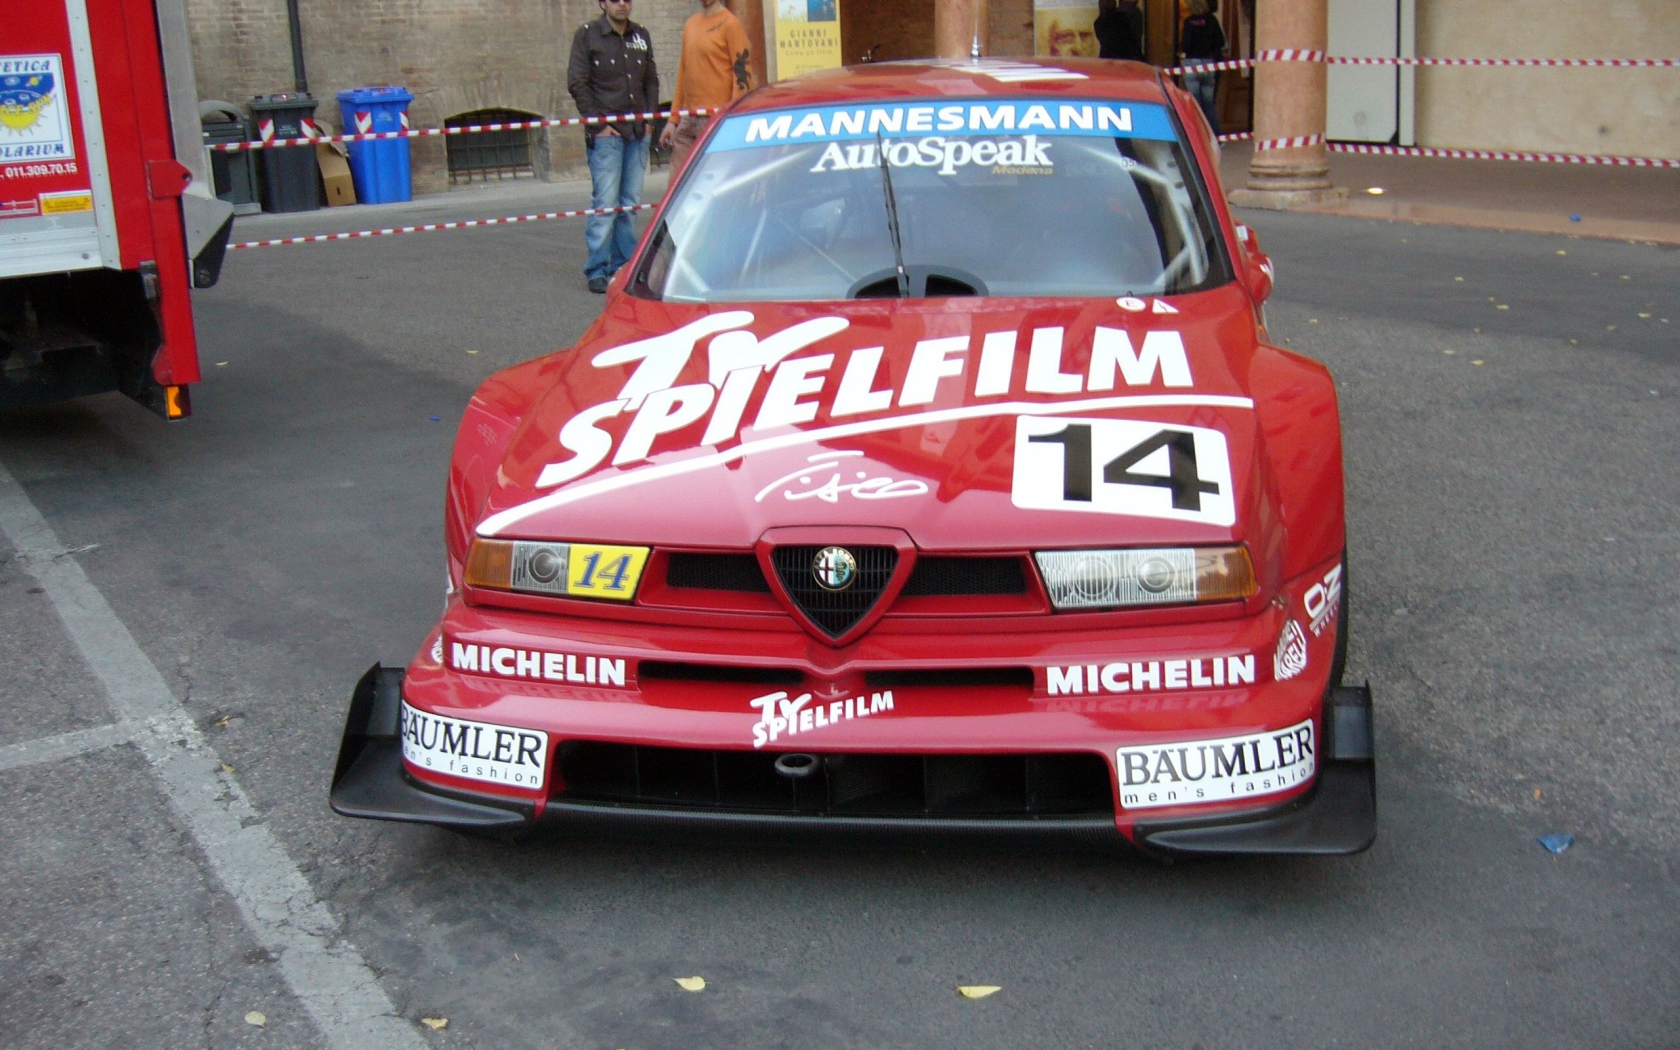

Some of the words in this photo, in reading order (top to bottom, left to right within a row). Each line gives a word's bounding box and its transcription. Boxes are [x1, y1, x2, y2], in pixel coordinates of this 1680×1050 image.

[780, 37, 839, 49] MANTOVANI
[790, 28, 827, 39] GIANNI
[744, 104, 1133, 142] MANNESMANN
[809, 134, 1054, 175] AutoSpeak
[992, 164, 1054, 175] Modena
[535, 326, 1194, 488] SPIELFILM
[1028, 423, 1220, 512] 14
[573, 551, 633, 591] 14
[452, 642, 626, 687] MICHELIN
[1046, 654, 1256, 696] MICHELIN
[752, 690, 895, 750] SPIELFILM
[403, 744, 433, 767] en's
[449, 759, 538, 785] fashion
[1121, 725, 1314, 787] BÄUMLER
[1123, 784, 1206, 804] men's
[1230, 762, 1314, 795] fashion
